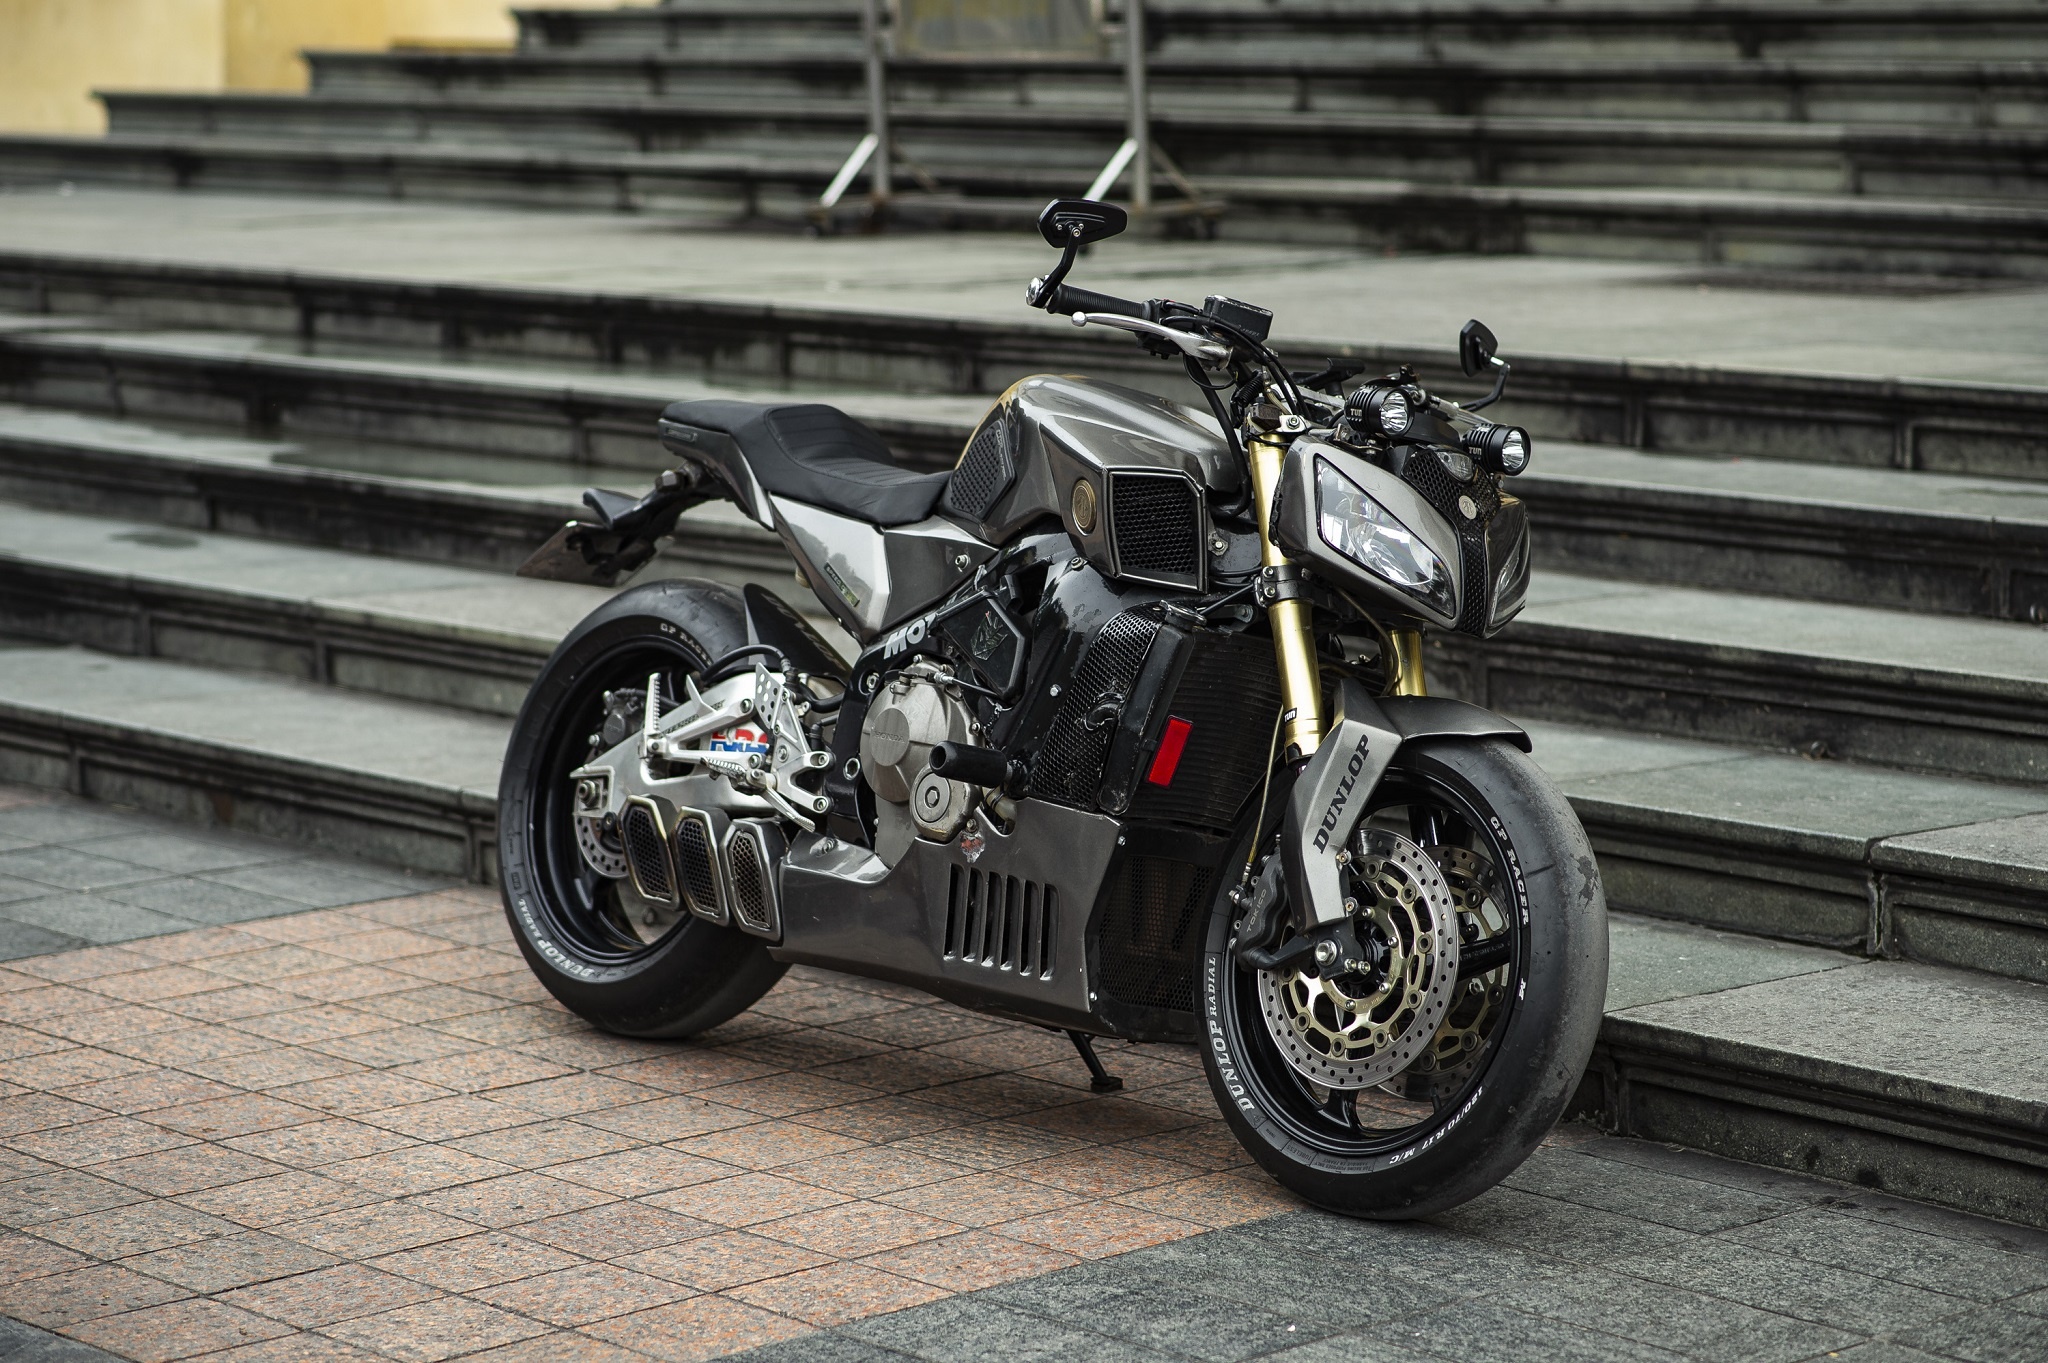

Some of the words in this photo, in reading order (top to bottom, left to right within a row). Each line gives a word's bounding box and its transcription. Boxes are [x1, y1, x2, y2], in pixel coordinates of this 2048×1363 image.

[873, 730, 905, 744] HONDA
[1313, 733, 1370, 854] DUNLOP
[1490, 816, 1508, 841] GP
[1506, 848, 1529, 925] RACER
[518, 898, 543, 938] RADIAL
[1246, 888, 1267, 933] TOKICO
[537, 939, 595, 978] DUNLOP
[1207, 956, 1218, 1017] RADIAL
[1209, 1019, 1255, 1112] DUNLOP
[1447, 1086, 1483, 1131] 120/70
[1286, 1144, 1312, 1162] TUBELESS
